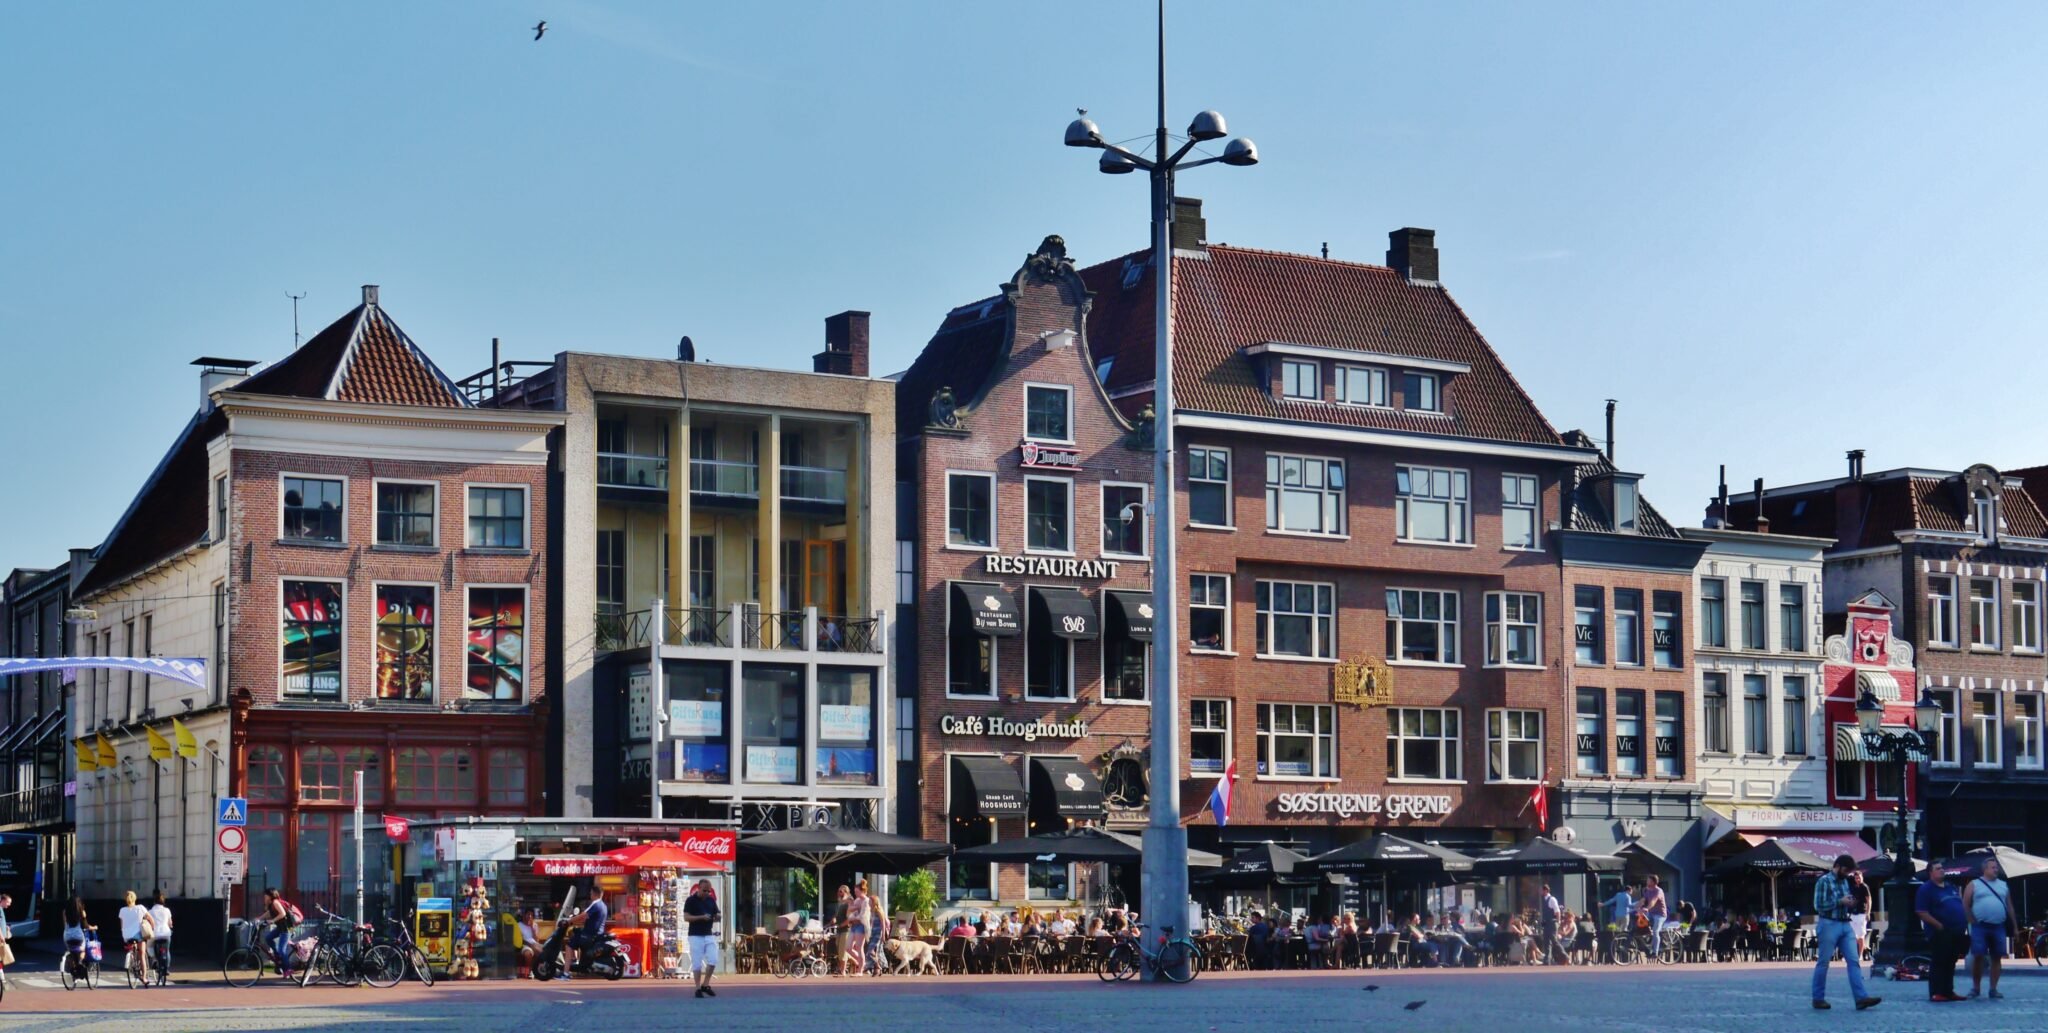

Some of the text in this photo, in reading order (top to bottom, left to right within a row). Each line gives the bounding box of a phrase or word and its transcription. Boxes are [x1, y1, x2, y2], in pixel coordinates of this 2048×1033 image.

[1038, 450, 1080, 467] Jupiler
[986, 554, 1120, 579] RESTAURANT
[1576, 625, 1593, 641] Vic
[1654, 630, 1671, 645] Vic
[291, 676, 336, 690] INGANG
[941, 714, 1089, 742] Café Hooghoudt
[1578, 735, 1595, 750] Vic
[1617, 736, 1634, 751] Vic
[1656, 738, 1673, 752] Vic
[1278, 792, 1452, 819] SØSTRENE GRENE
[730, 805, 831, 830] EXPO
[1794, 812, 1833, 822] VENEZIA
[1620, 818, 1647, 838] Vic
[684, 836, 732, 855] Coca-Cola
[545, 863, 625, 875] Gekoelde frisdranken
